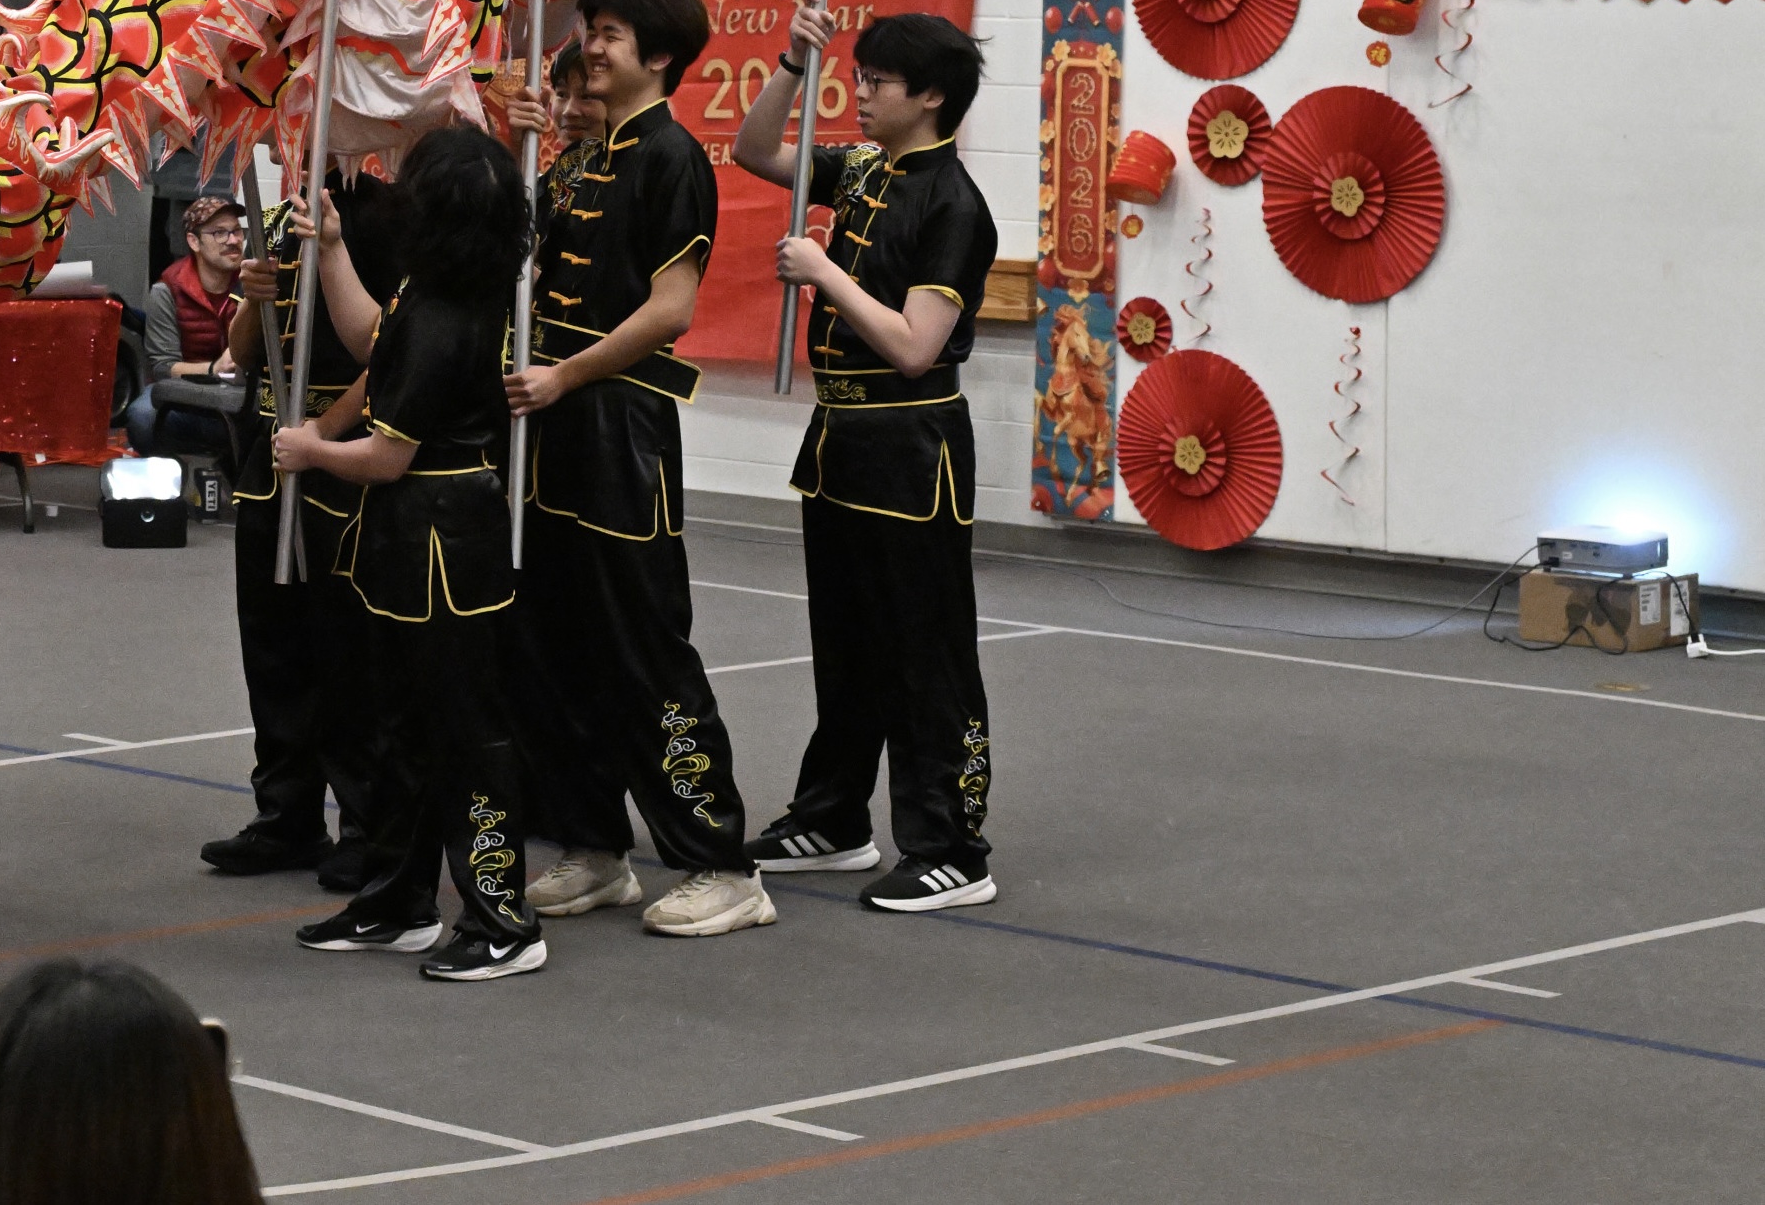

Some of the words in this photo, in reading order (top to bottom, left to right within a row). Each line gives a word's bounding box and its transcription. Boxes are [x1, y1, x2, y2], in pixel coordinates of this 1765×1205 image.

[702, 56, 848, 119] 206
[1067, 72, 1098, 261] 2026
[207, 481, 217, 510] YETI
